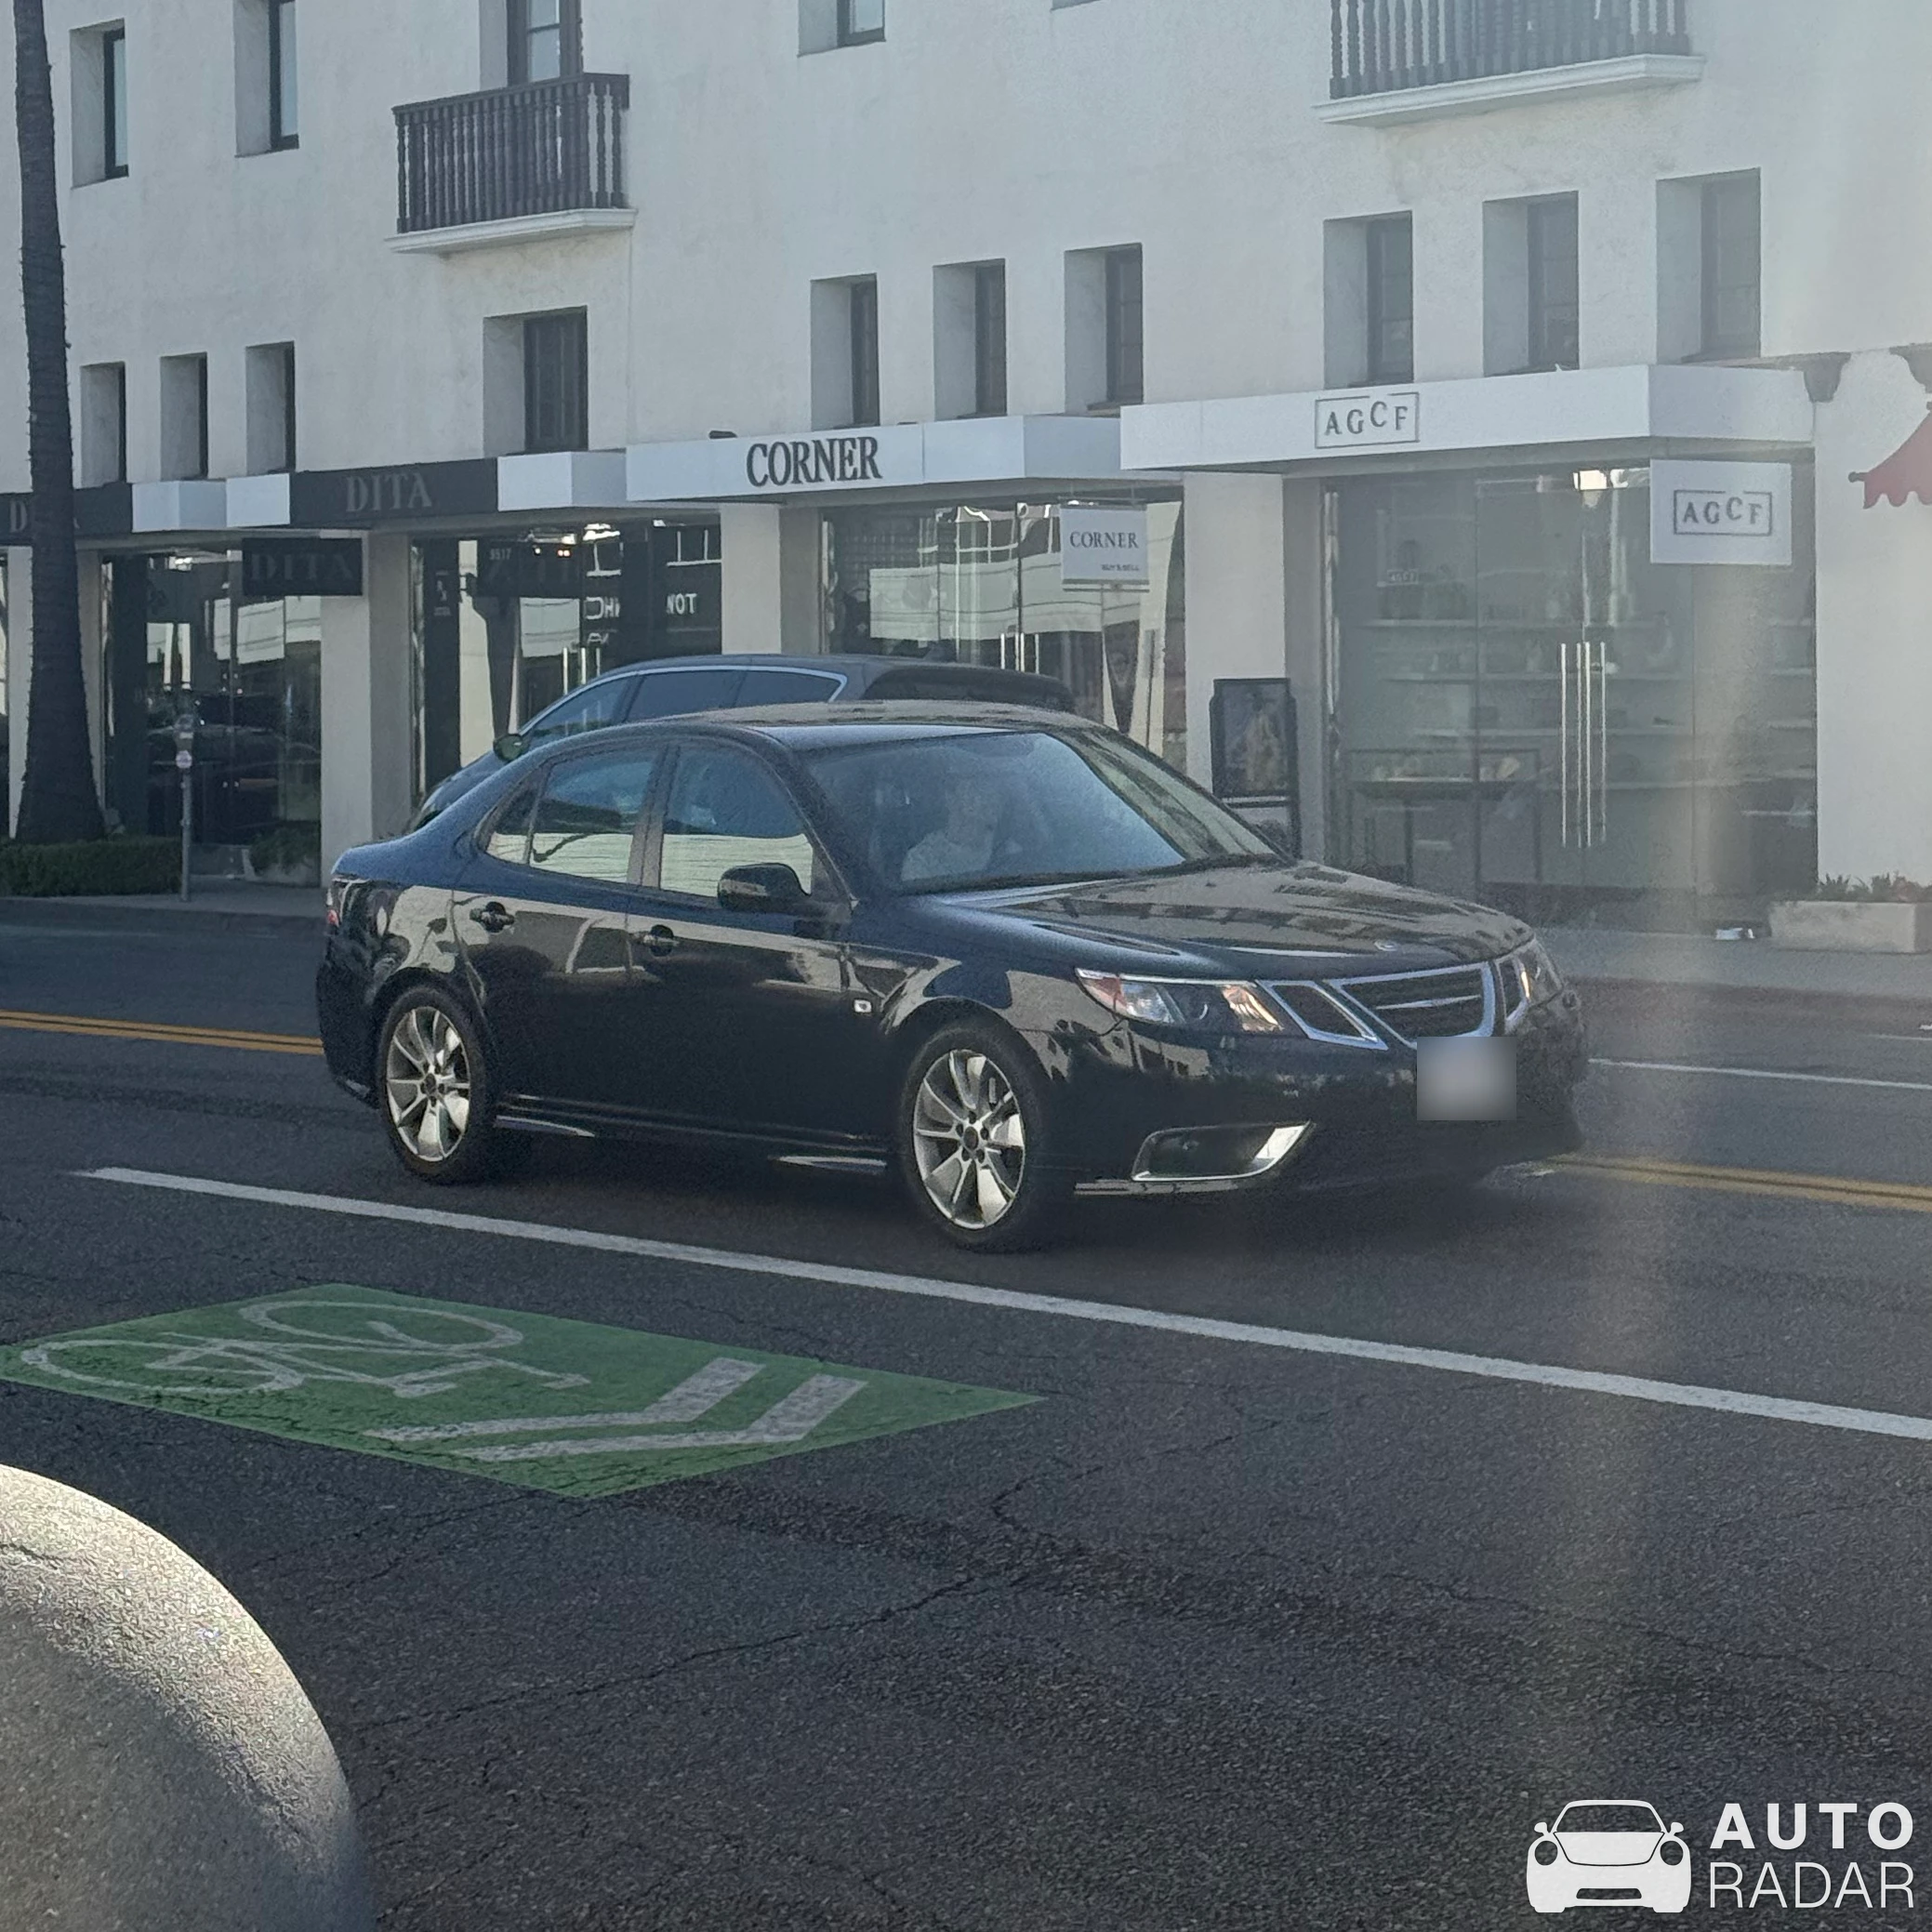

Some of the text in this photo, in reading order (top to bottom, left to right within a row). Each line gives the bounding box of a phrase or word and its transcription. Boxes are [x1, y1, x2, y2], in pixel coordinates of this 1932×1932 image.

[1324, 401, 1408, 436] AGCF
[746, 436, 882, 487] CORNER
[345, 472, 432, 513] DITA
[1682, 496, 1763, 524] AGCF
[1069, 531, 1139, 549] CORNER
[250, 554, 354, 581] DITA
